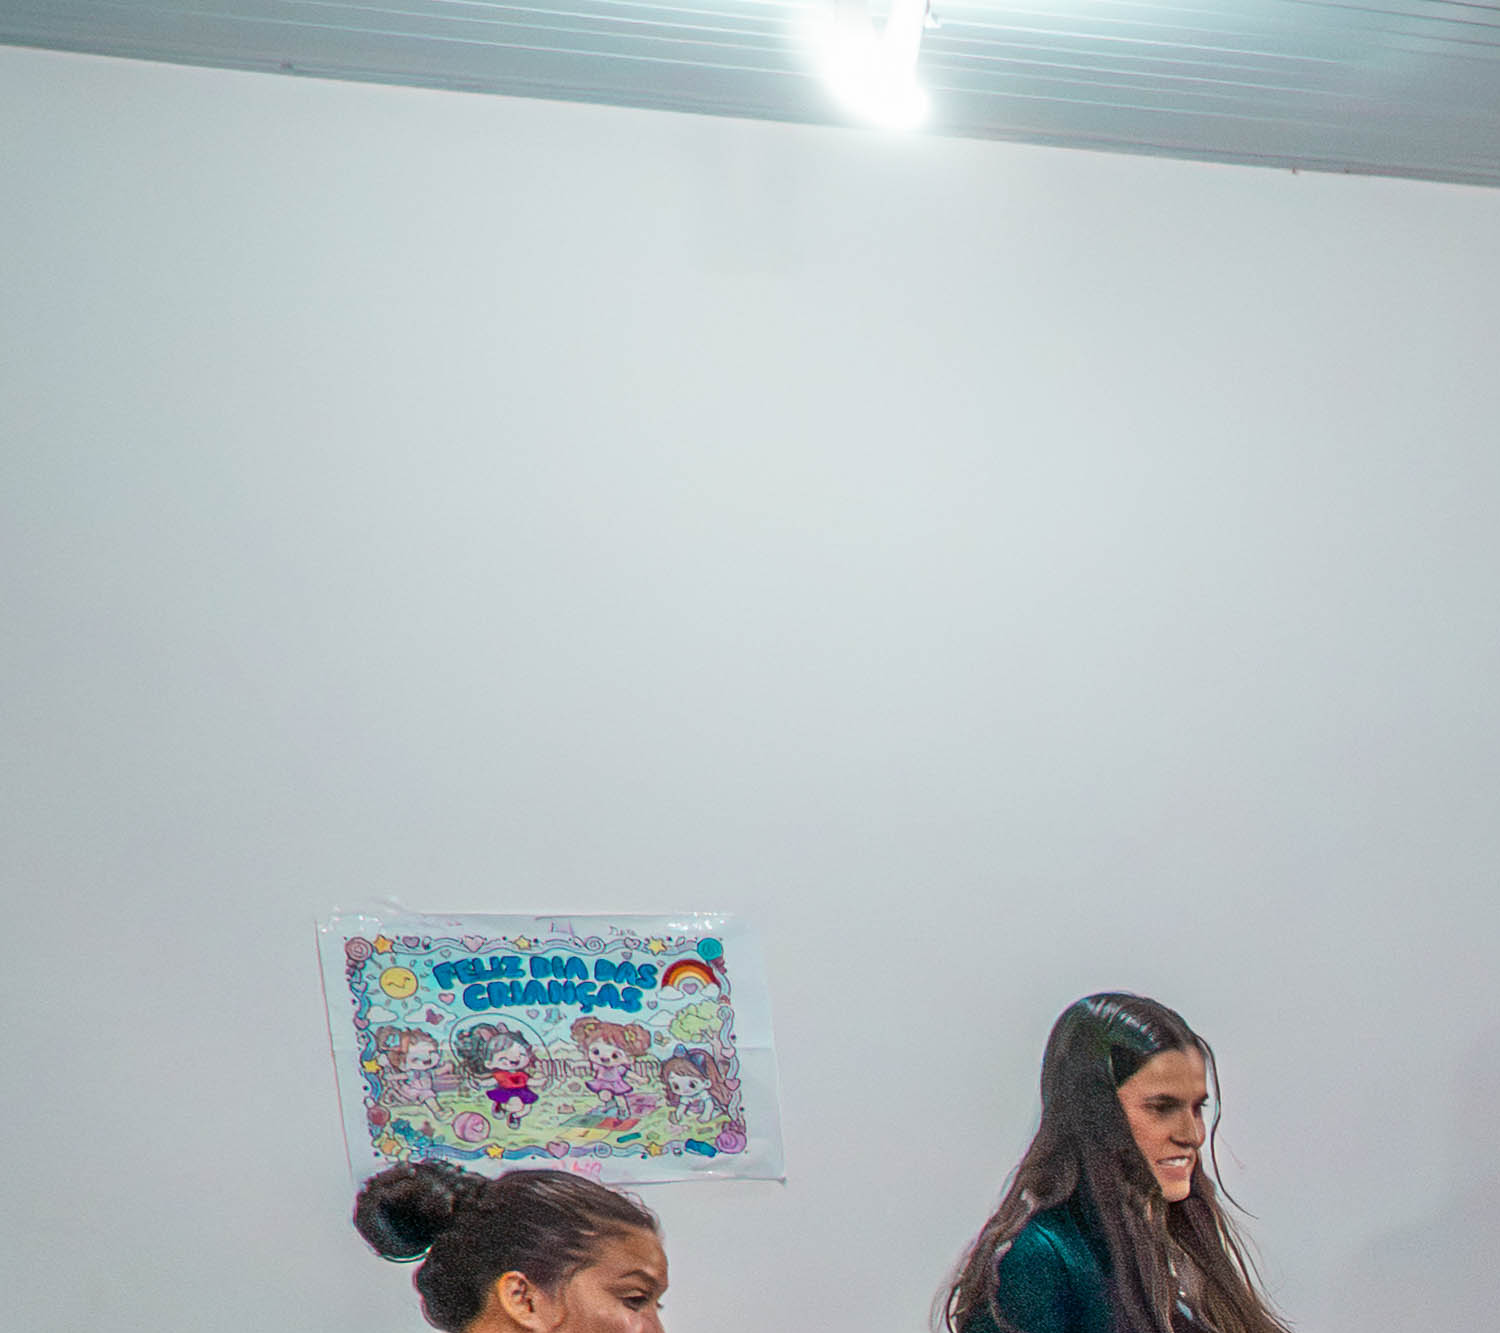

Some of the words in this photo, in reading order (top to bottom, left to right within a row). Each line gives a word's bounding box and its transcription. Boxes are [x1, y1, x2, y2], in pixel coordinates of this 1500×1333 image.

[432, 955, 527, 990] FELIZ
[529, 956, 589, 981] DIA
[594, 958, 658, 990] DAS
[463, 979, 643, 1013] CRIANÇAS
